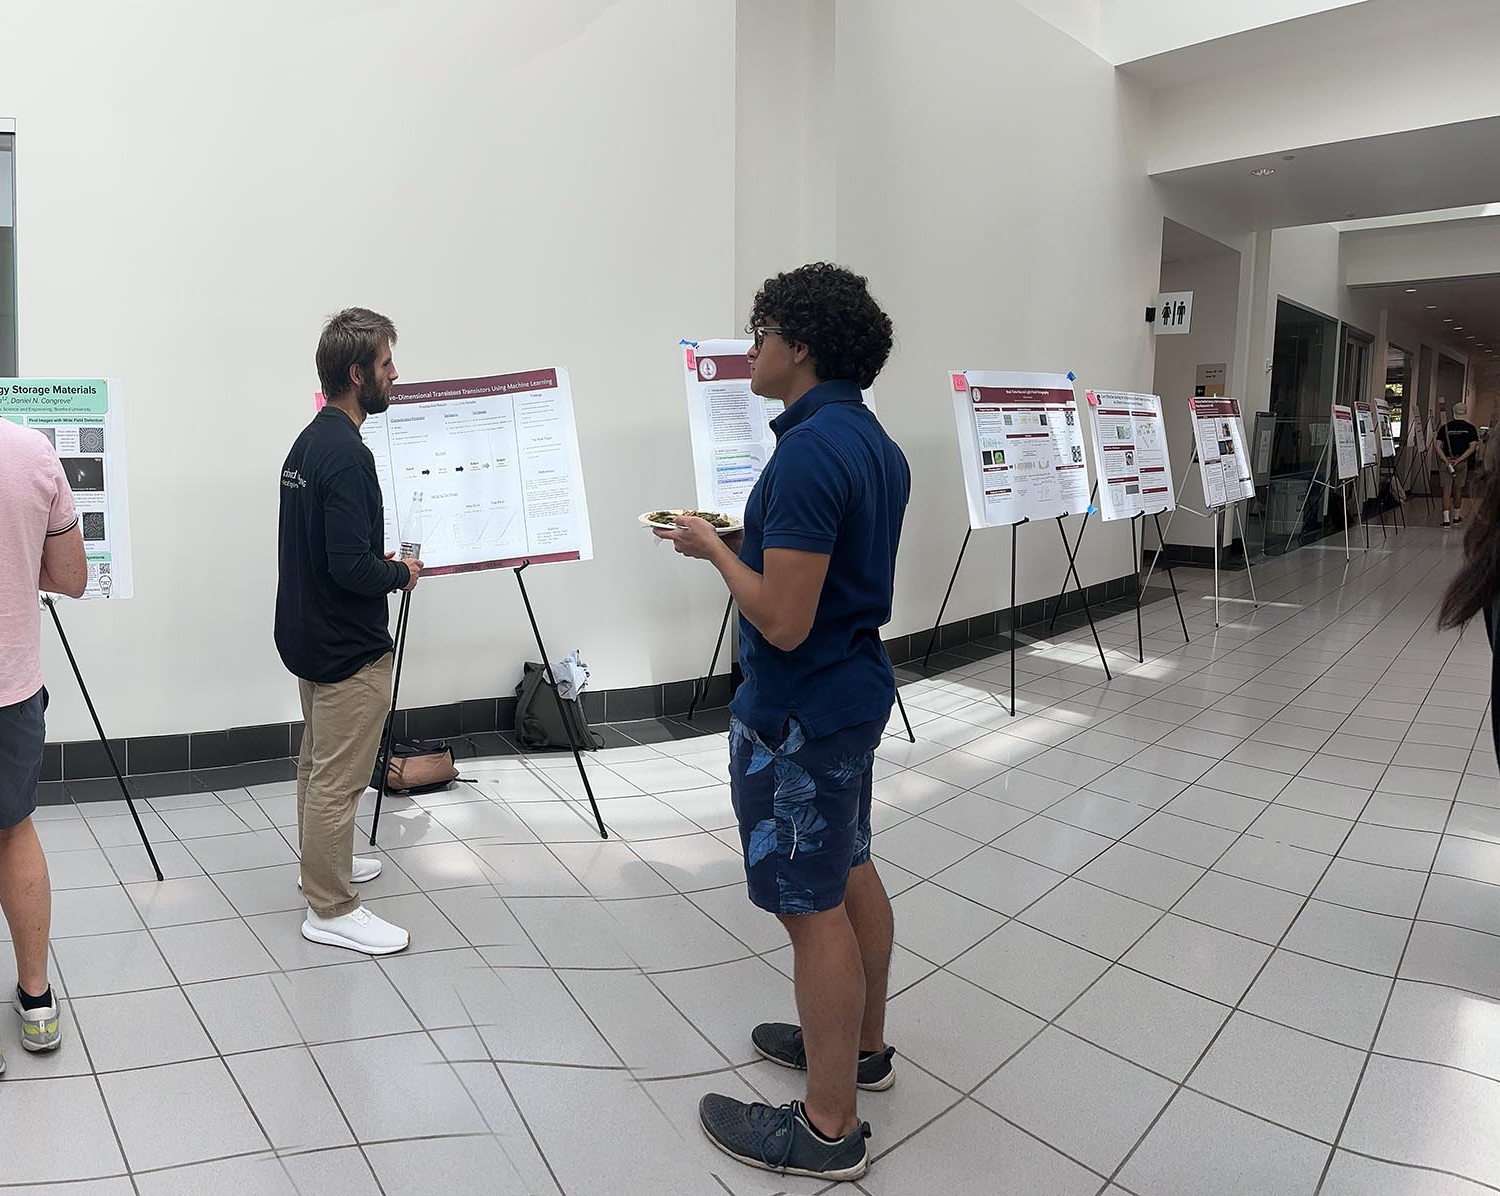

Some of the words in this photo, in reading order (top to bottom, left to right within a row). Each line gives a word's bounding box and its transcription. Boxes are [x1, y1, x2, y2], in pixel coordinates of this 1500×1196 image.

[507, 382, 529, 390] Machine
[530, 379, 553, 387] Learning
[12, 385, 50, 396] Storage
[52, 385, 97, 394] Materials
